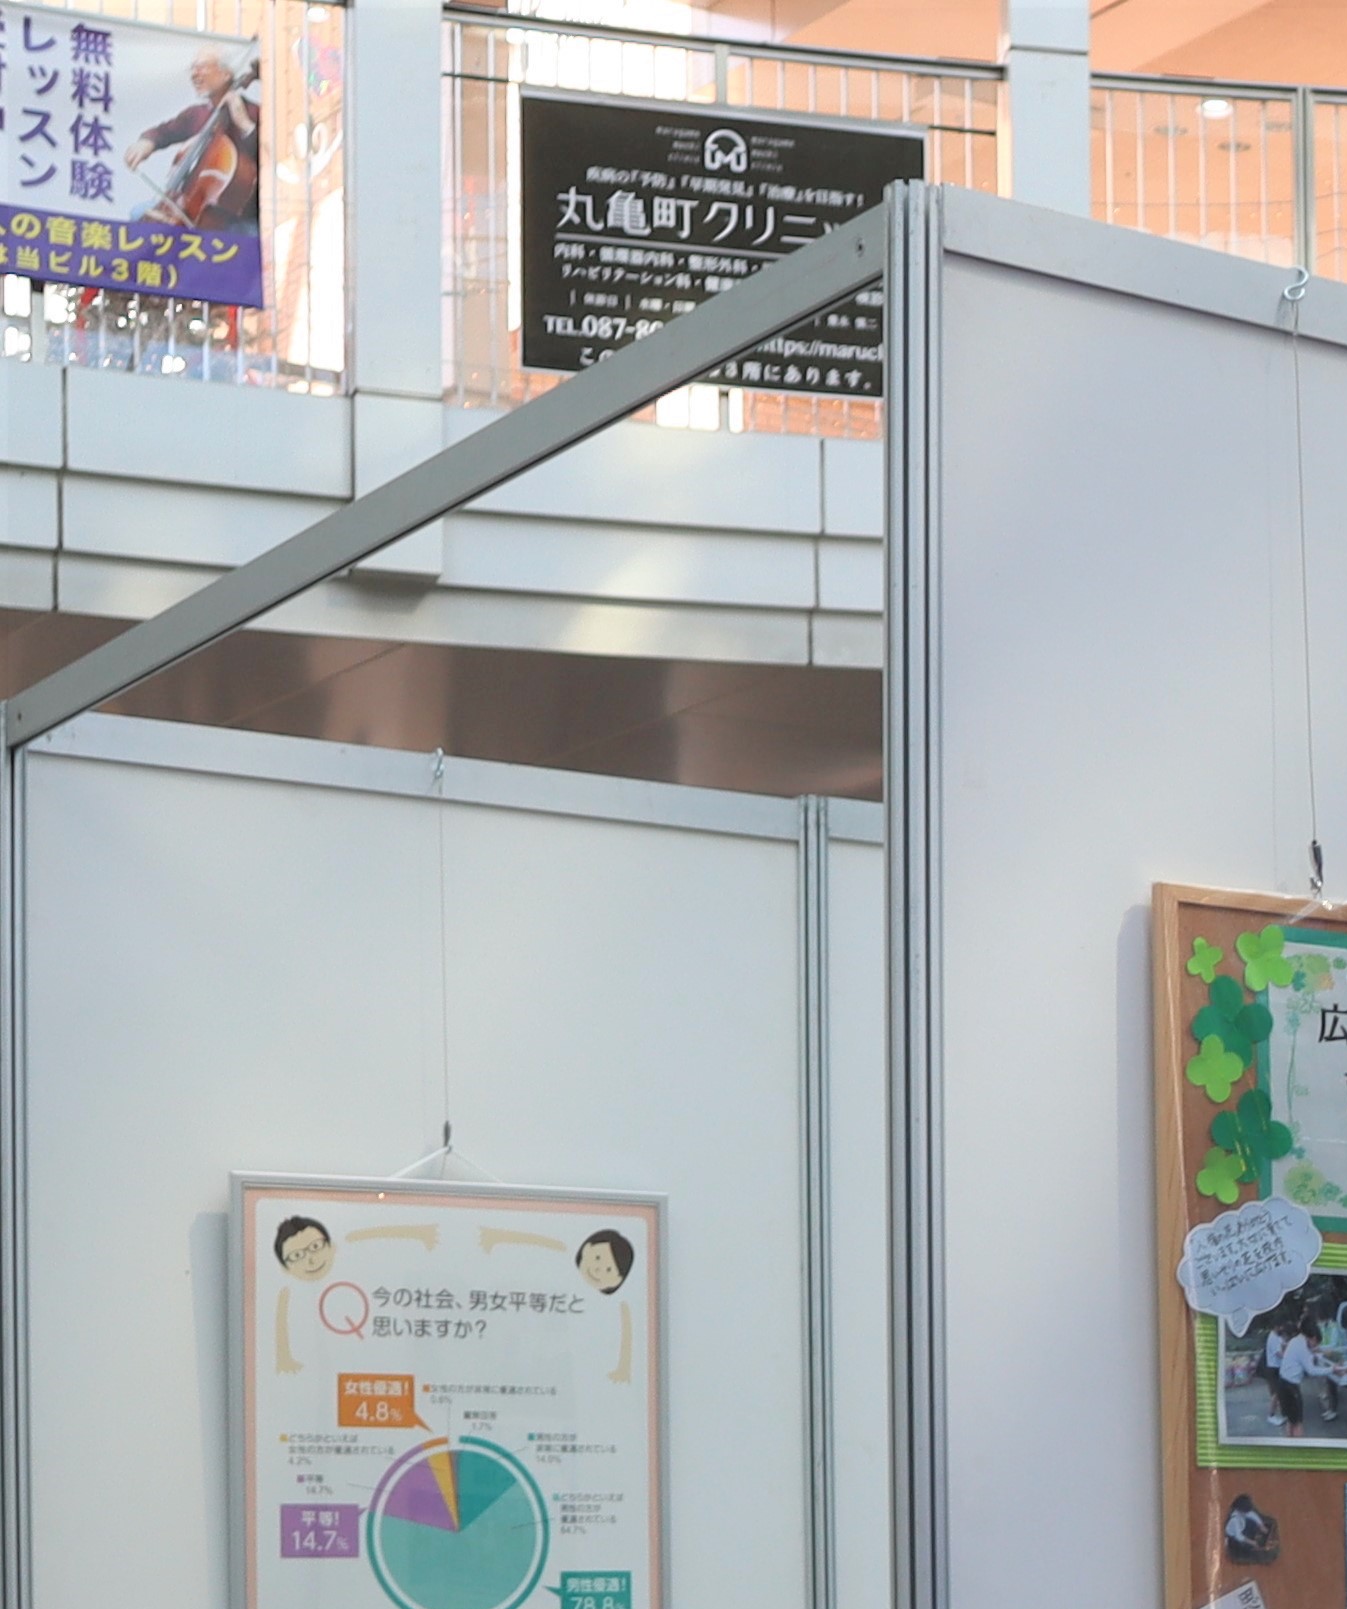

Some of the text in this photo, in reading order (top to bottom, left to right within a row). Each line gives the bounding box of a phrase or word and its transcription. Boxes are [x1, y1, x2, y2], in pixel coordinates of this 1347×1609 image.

[19, 16, 59, 187] レッスン
[70, 22, 114, 203] 無料体験
[0, 213, 239, 264] の音楽レッスン
[319, 1281, 369, 1340] Q
[372, 1286, 586, 1315] 今の社会、男女平等だと
[372, 1319, 488, 1340] 思いますか?
[355, 1401, 403, 1421] 4.8%
[292, 1530, 349, 1551] 14.7%
